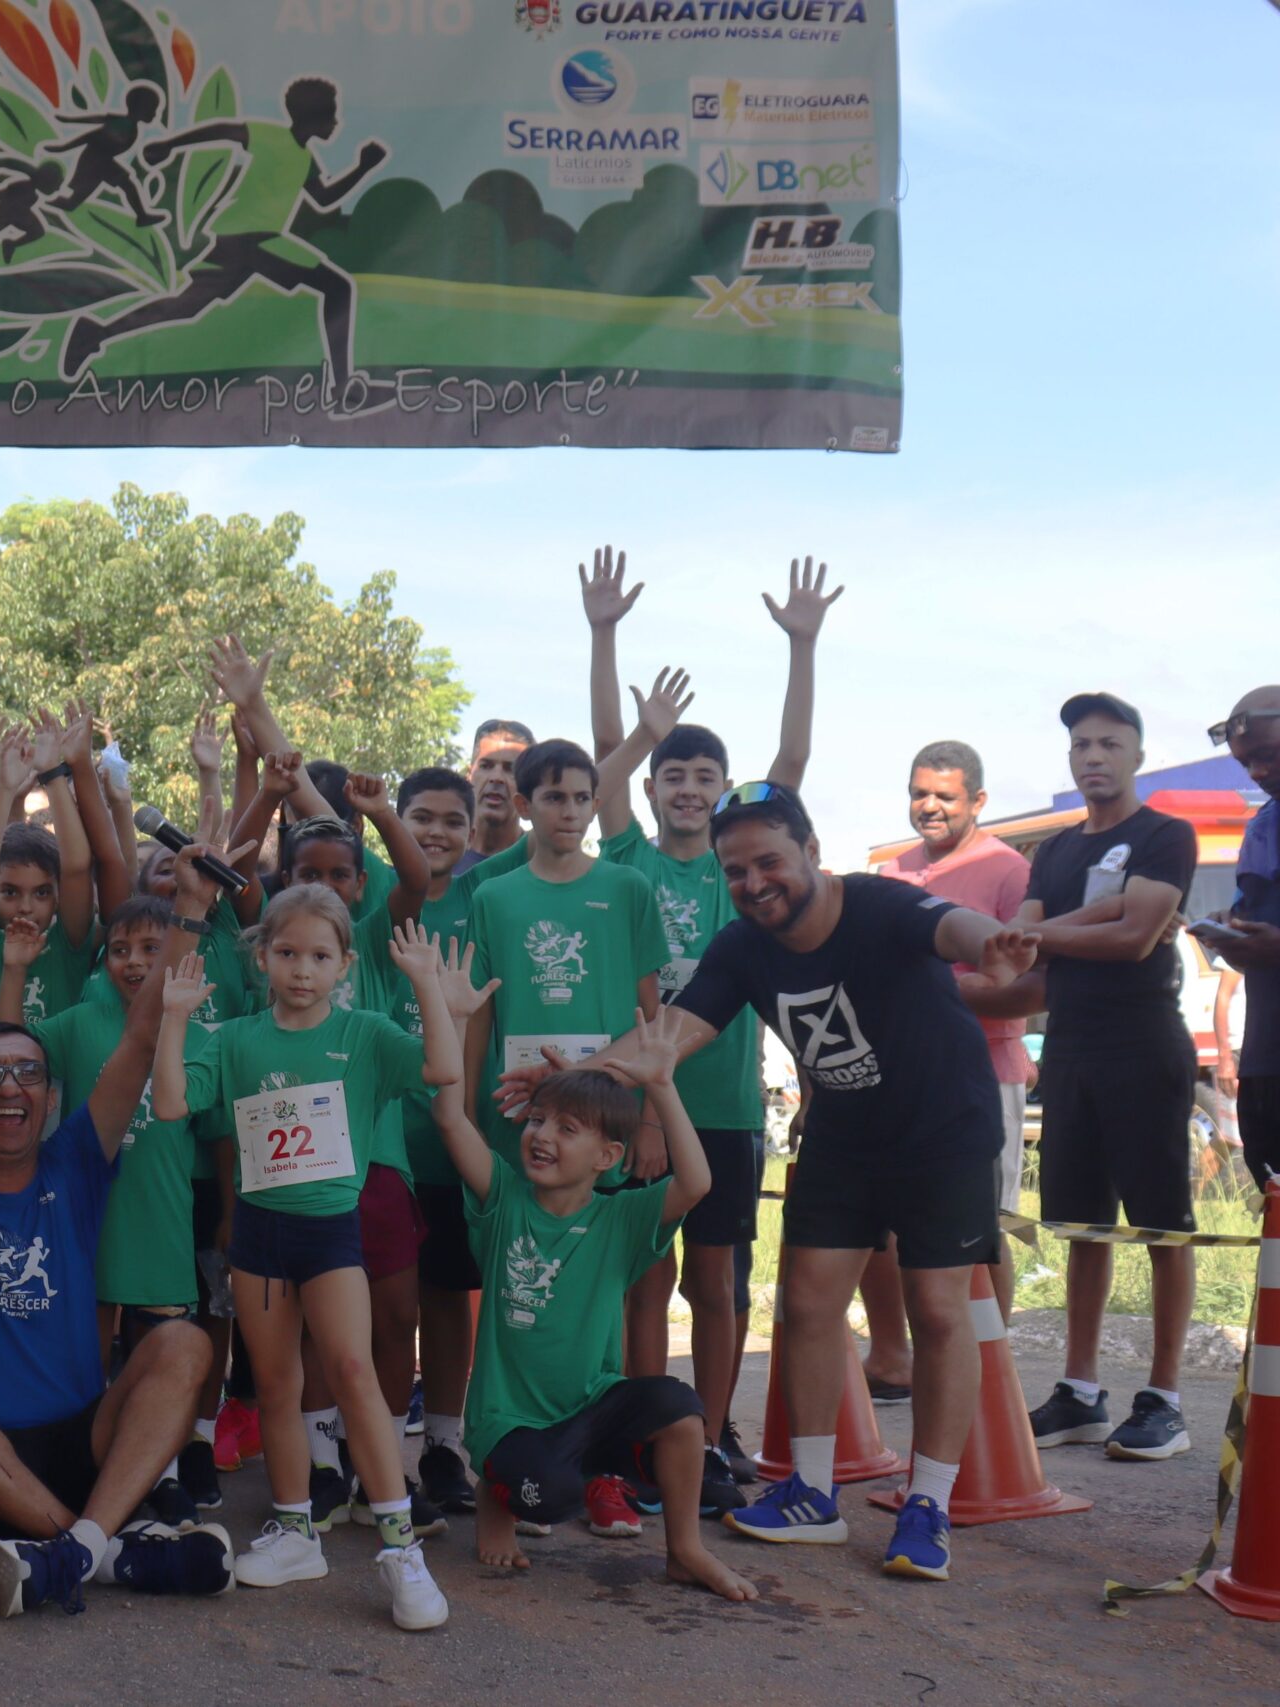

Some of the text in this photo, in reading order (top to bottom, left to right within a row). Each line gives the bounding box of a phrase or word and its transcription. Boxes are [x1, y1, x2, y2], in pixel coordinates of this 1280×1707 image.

[605, 26, 842, 42] FORTE COMO NOSSA GENTE
[507, 120, 681, 152] SERRAMAR
[11, 381, 39, 415] o
[57, 369, 239, 415] Amor
[255, 359, 368, 436] pelo
[531, 973, 582, 985] FLORESCER
[267, 1125, 316, 1160] 22
[264, 1161, 298, 1174] Isabela
